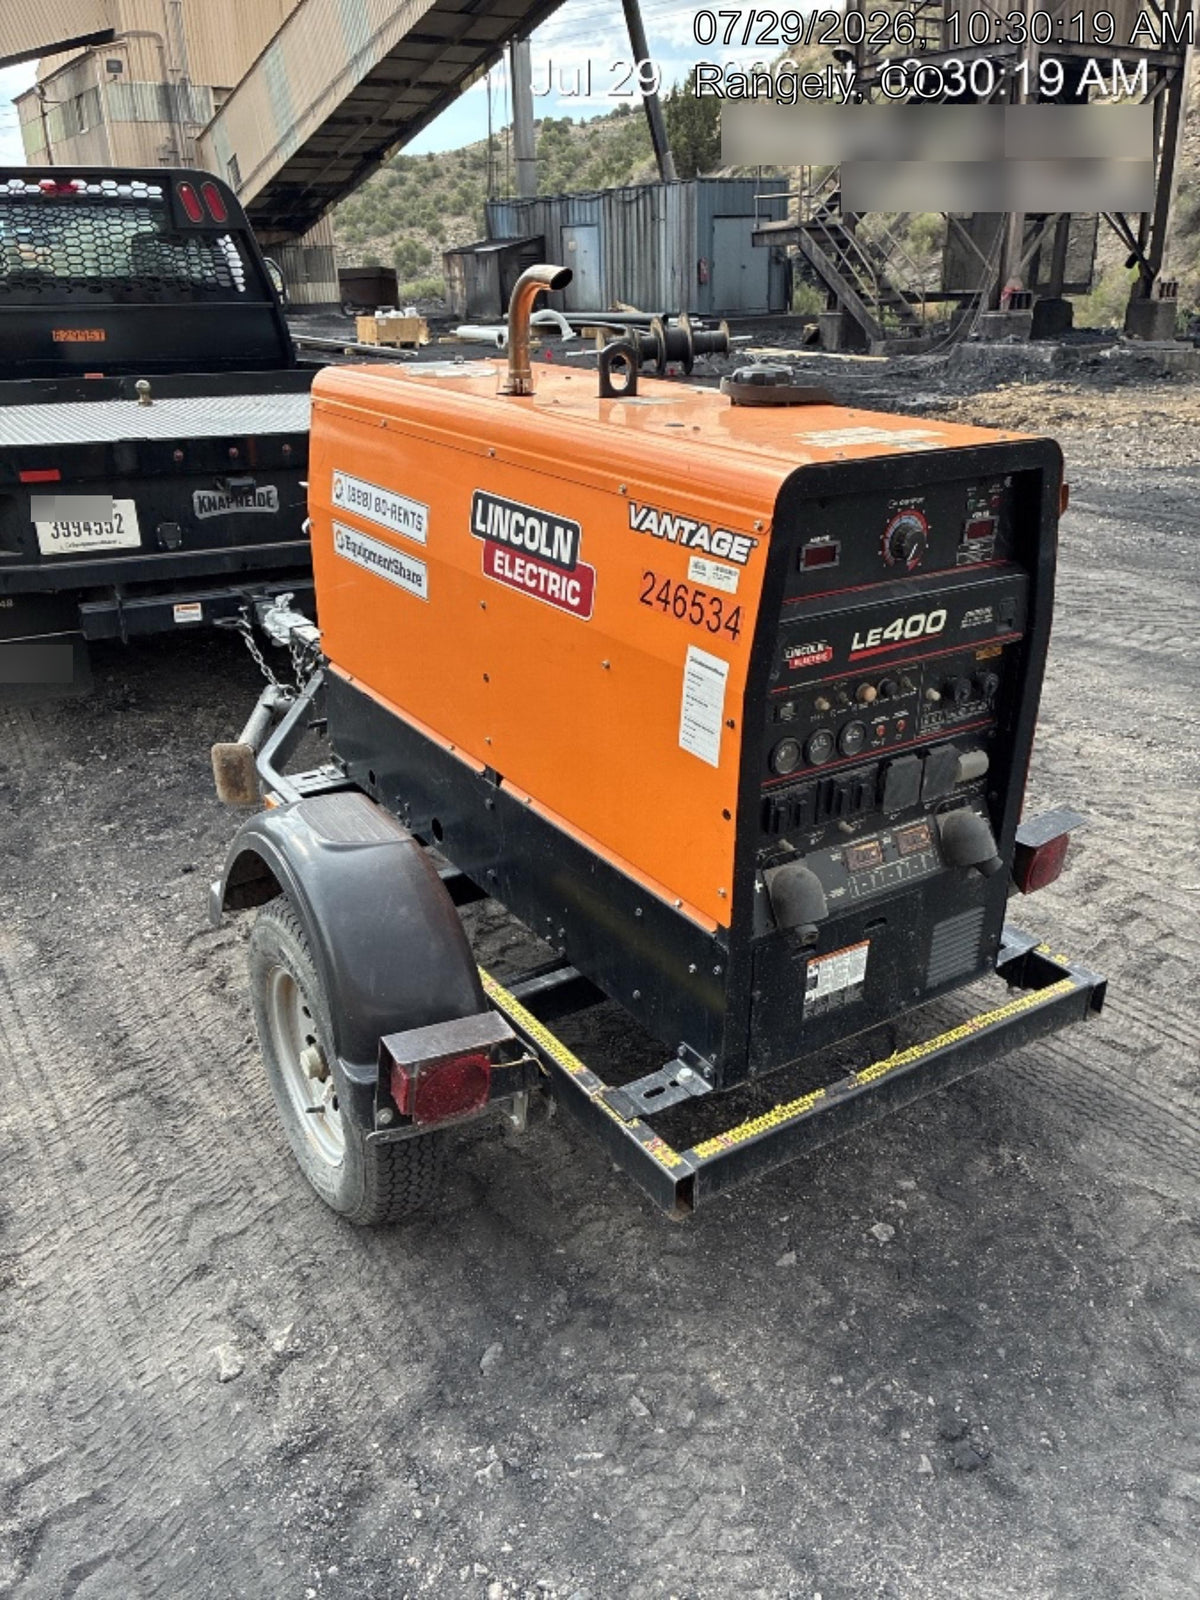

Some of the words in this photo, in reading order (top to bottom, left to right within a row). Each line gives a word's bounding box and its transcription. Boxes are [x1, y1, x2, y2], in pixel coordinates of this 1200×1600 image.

[197, 490, 274, 514] KNAPHEIDE
[374, 496, 423, 532] 80-RENTS
[475, 498, 574, 565] LINCOLN
[628, 501, 753, 565] VANTAGE
[344, 534, 423, 588] EquipmentShare
[493, 549, 581, 607] ELECTRIC
[639, 570, 741, 642] 246534
[851, 609, 947, 651] LE400
